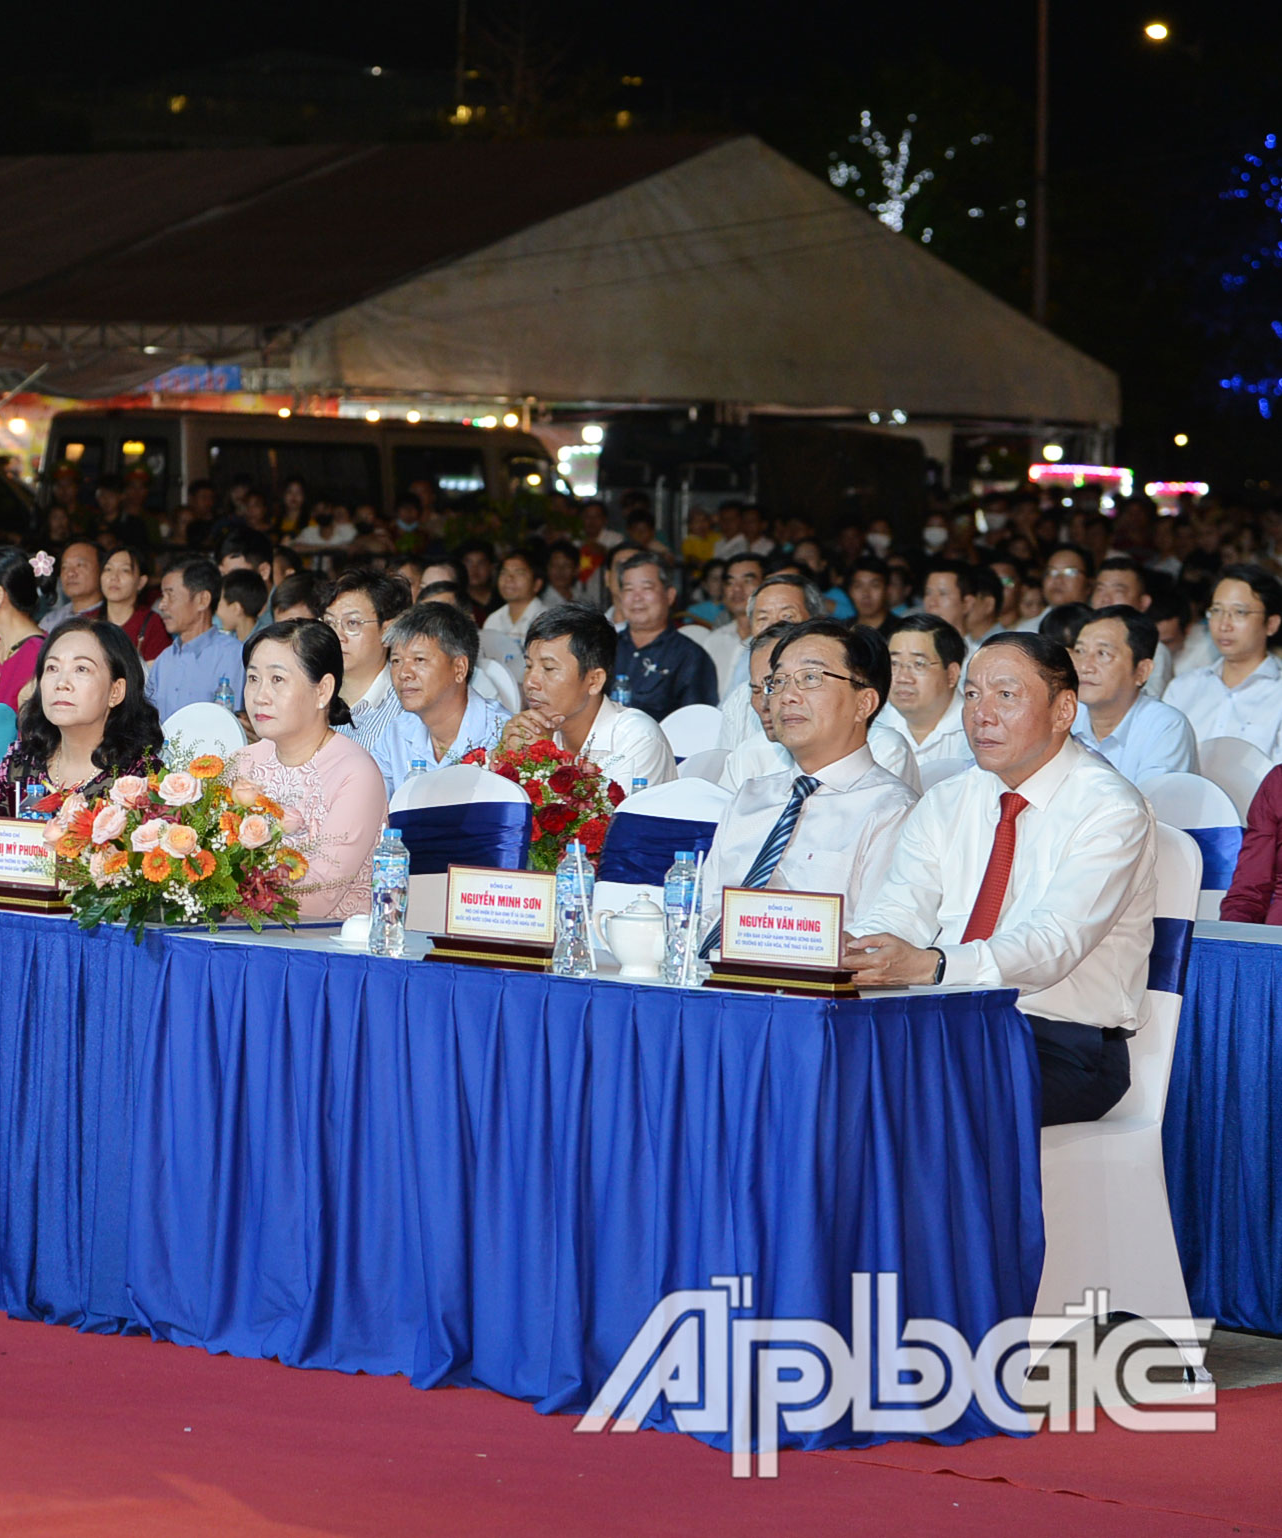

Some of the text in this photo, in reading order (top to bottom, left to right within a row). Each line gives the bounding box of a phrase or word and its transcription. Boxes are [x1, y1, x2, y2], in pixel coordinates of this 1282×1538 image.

[6, 842, 16, 855] MỸ
[19, 844, 48, 857] PHƯƠNG
[461, 891, 542, 910] NGUYỄN MINH SƠN
[739, 912, 821, 932] NGUYỄN VĂN HÙNG
